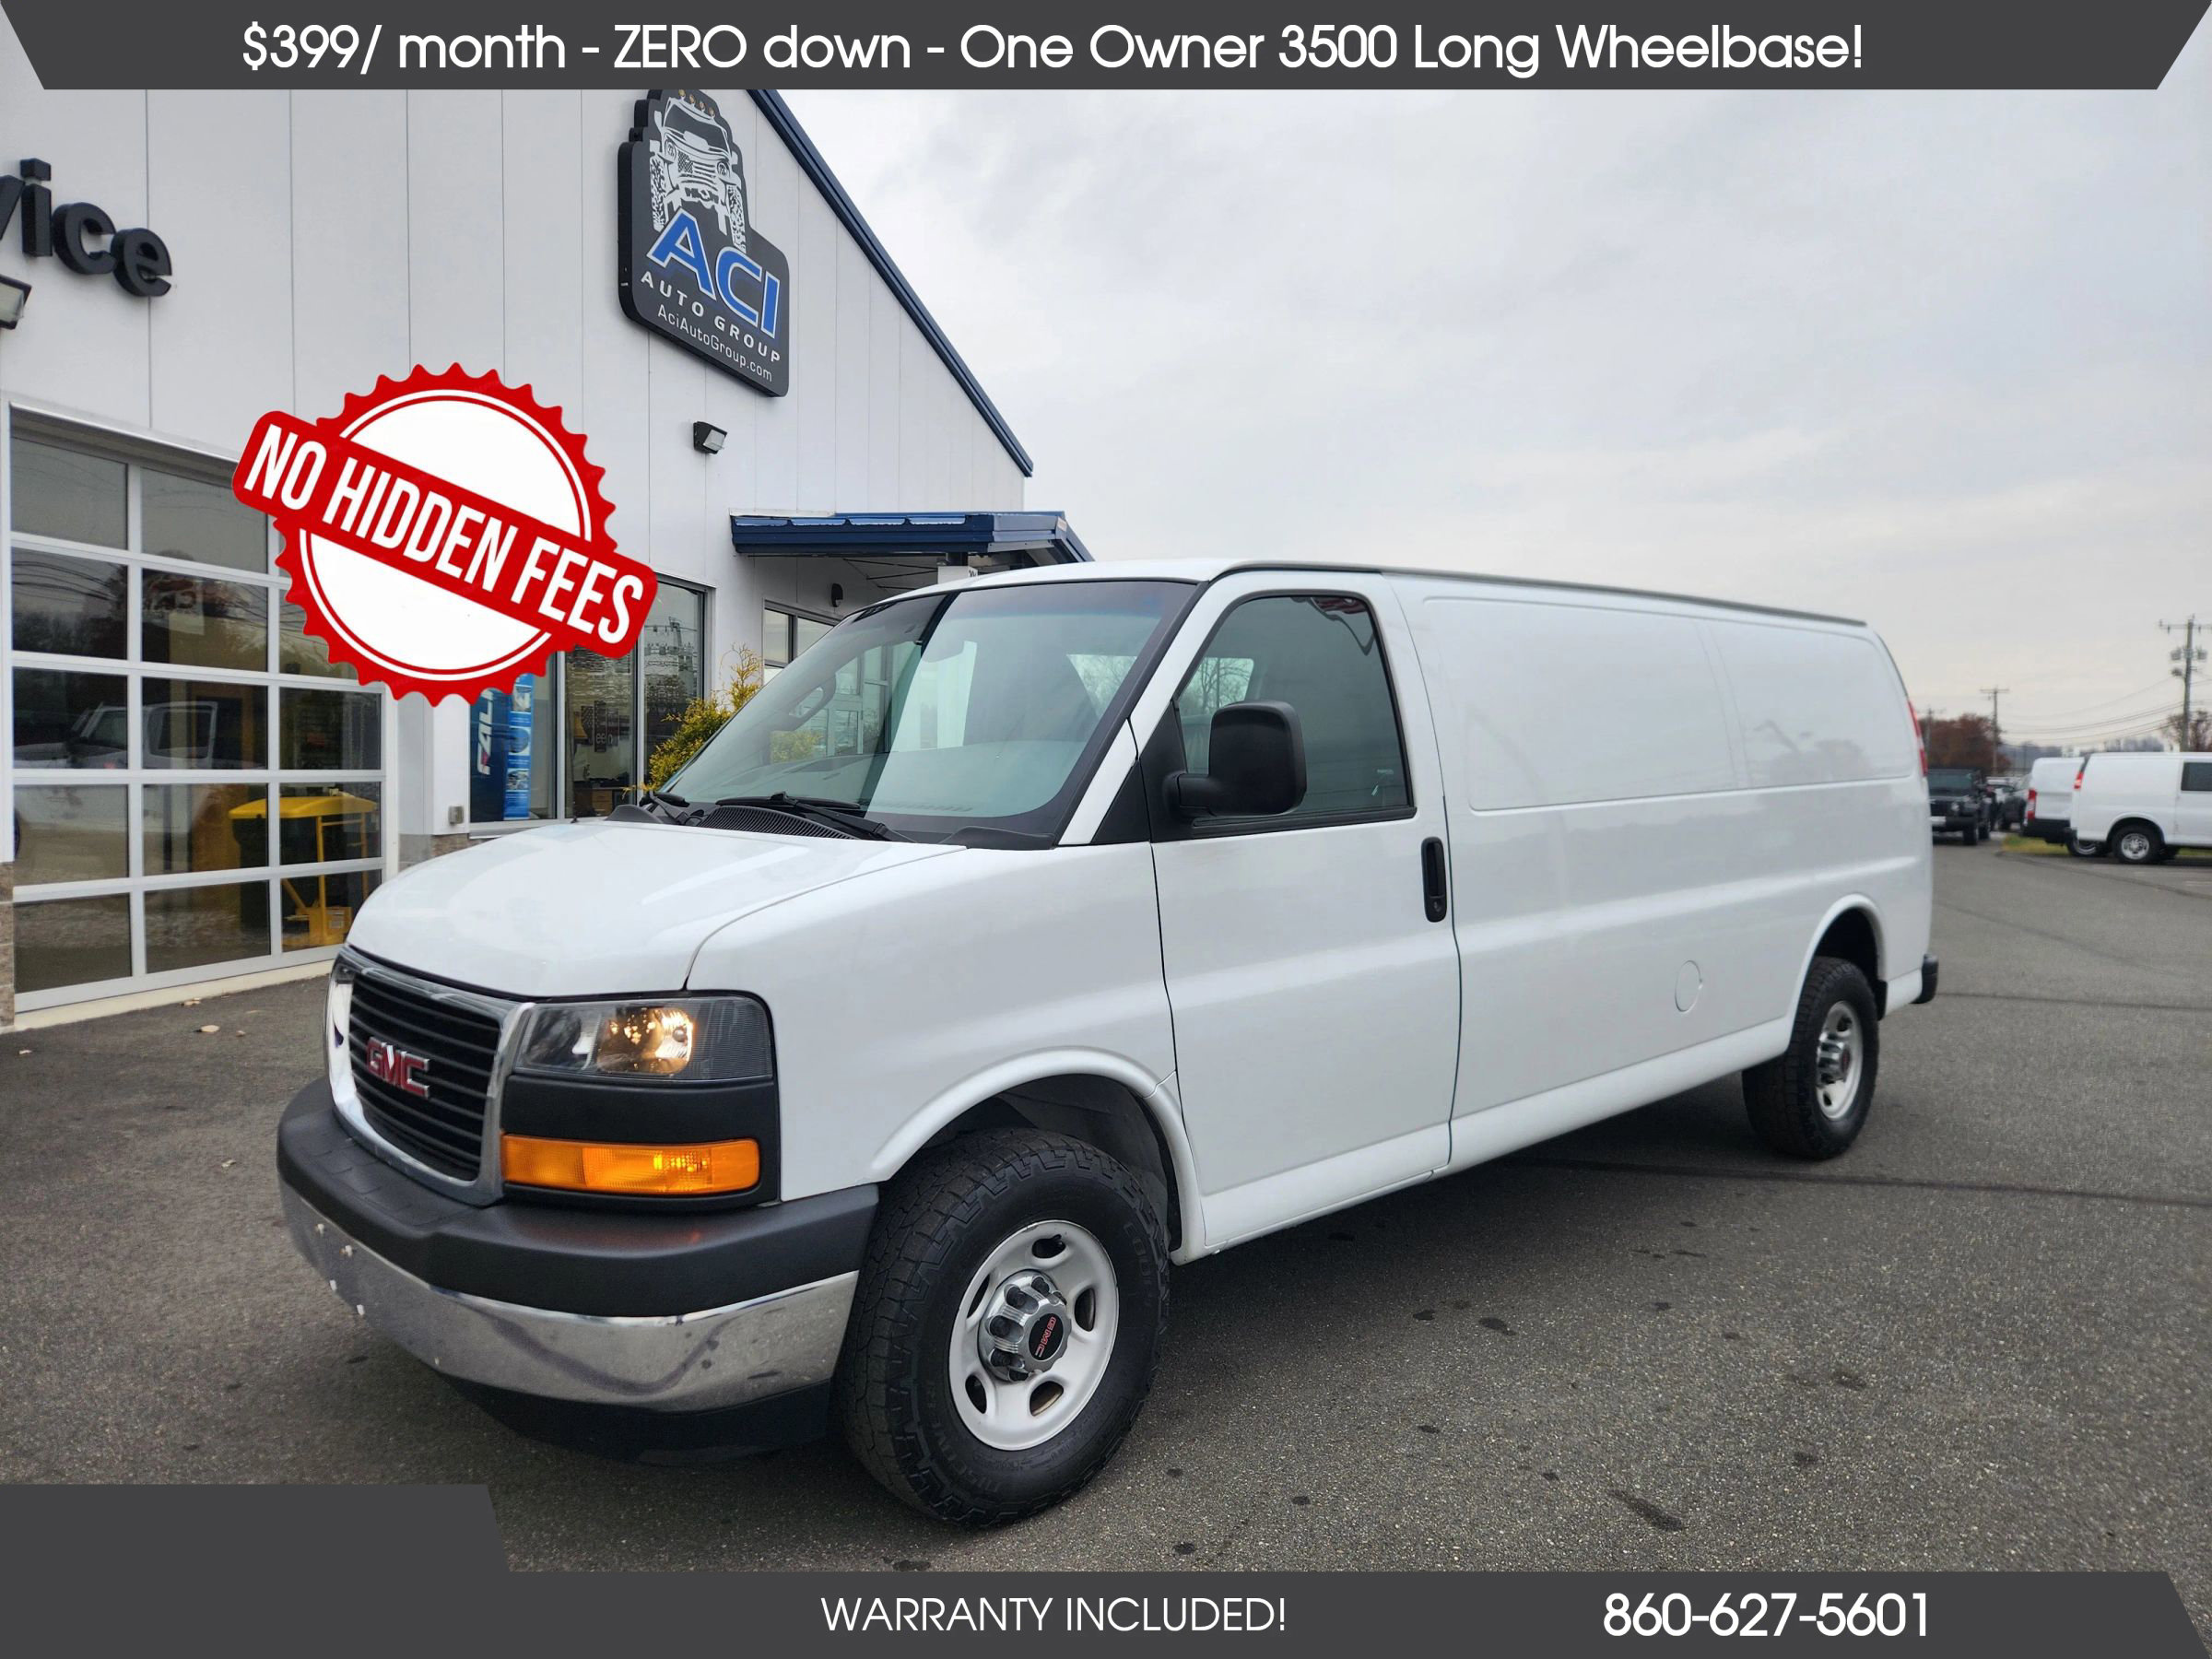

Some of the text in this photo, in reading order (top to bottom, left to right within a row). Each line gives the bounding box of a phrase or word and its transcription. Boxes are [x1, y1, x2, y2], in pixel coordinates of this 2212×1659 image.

[646, 207, 781, 339] ACI
[641, 270, 781, 363] AUTO GROUP
[657, 304, 772, 382] AciAutoGroup.com
[367, 1036, 429, 1100] GMC
[1034, 1315, 1057, 1359] GMC
